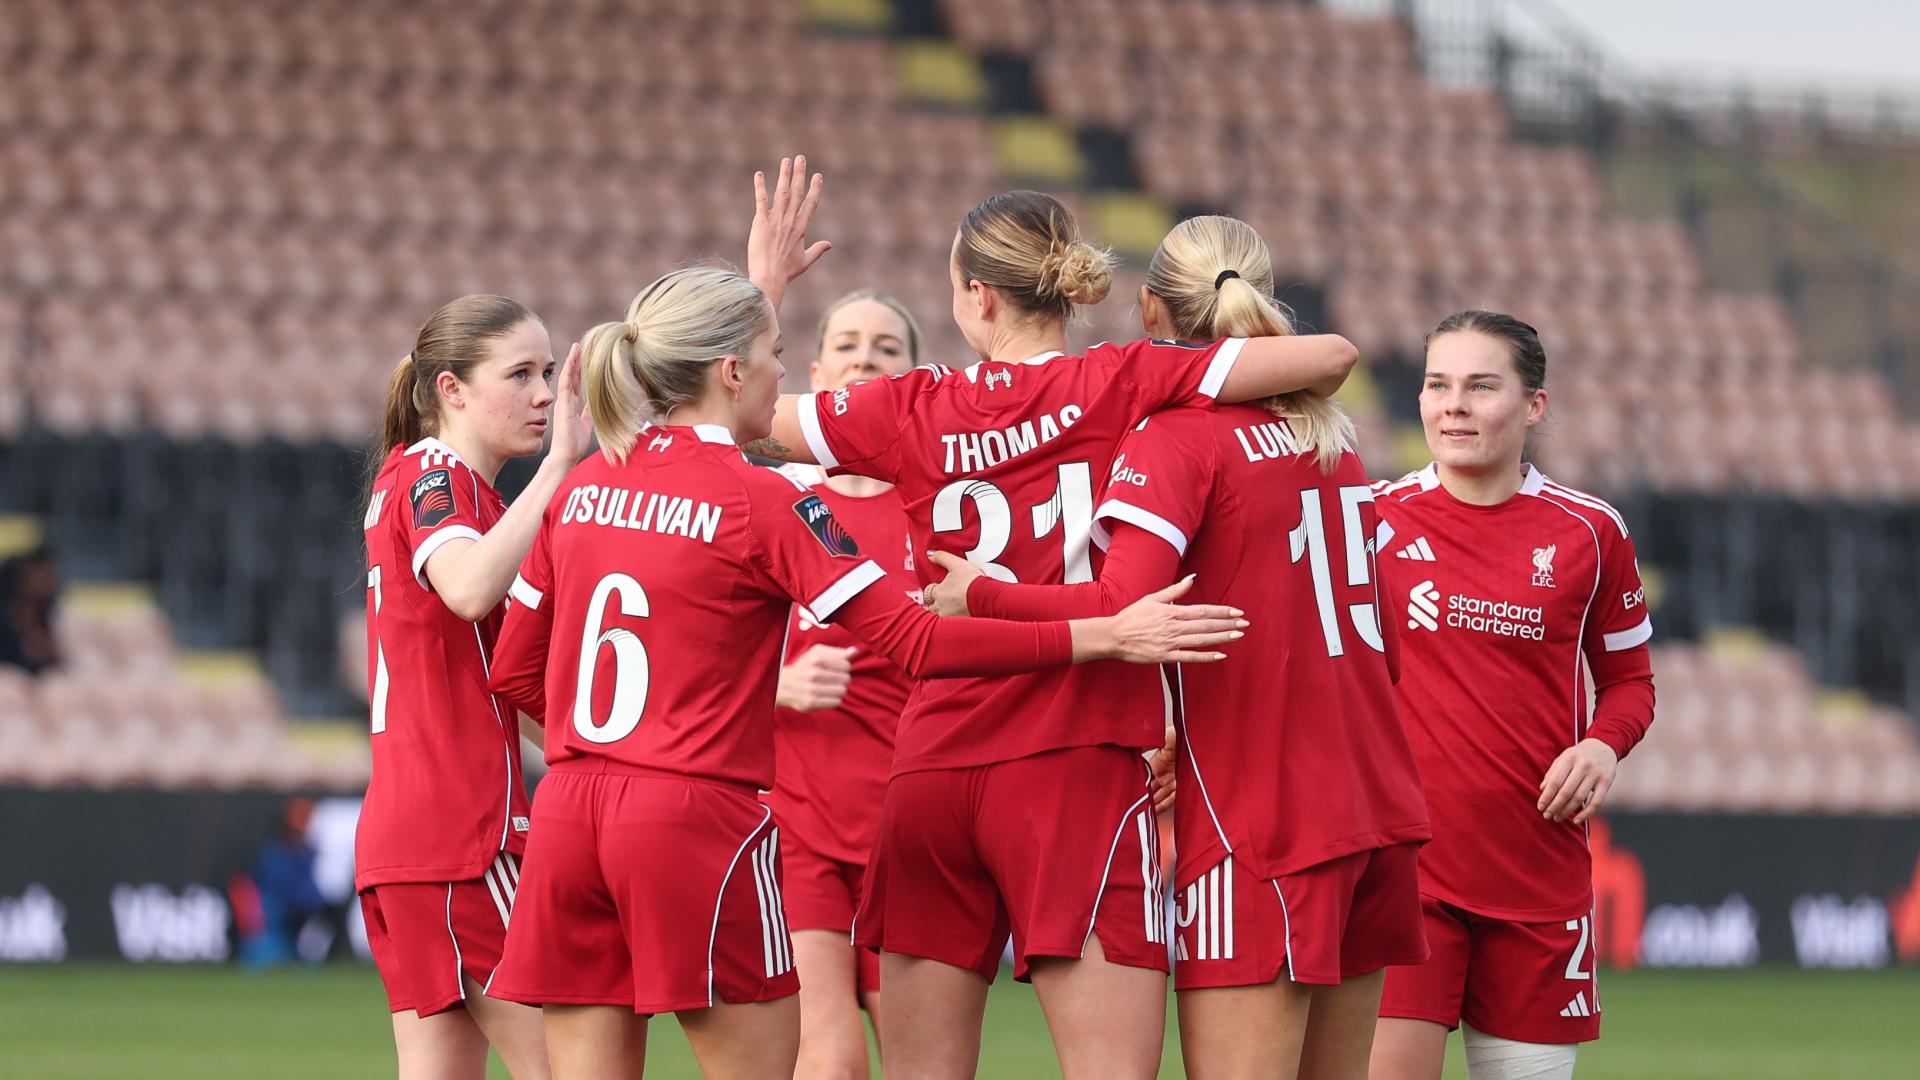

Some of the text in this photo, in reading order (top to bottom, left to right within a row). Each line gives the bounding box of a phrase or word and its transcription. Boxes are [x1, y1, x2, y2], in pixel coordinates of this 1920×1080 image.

[561, 484, 723, 544] O'SULLIVAN
[1288, 485, 1384, 658] 15
[1446, 611, 1546, 641] chartered
[1447, 593, 1543, 623] standard
[573, 572, 650, 744] 6
